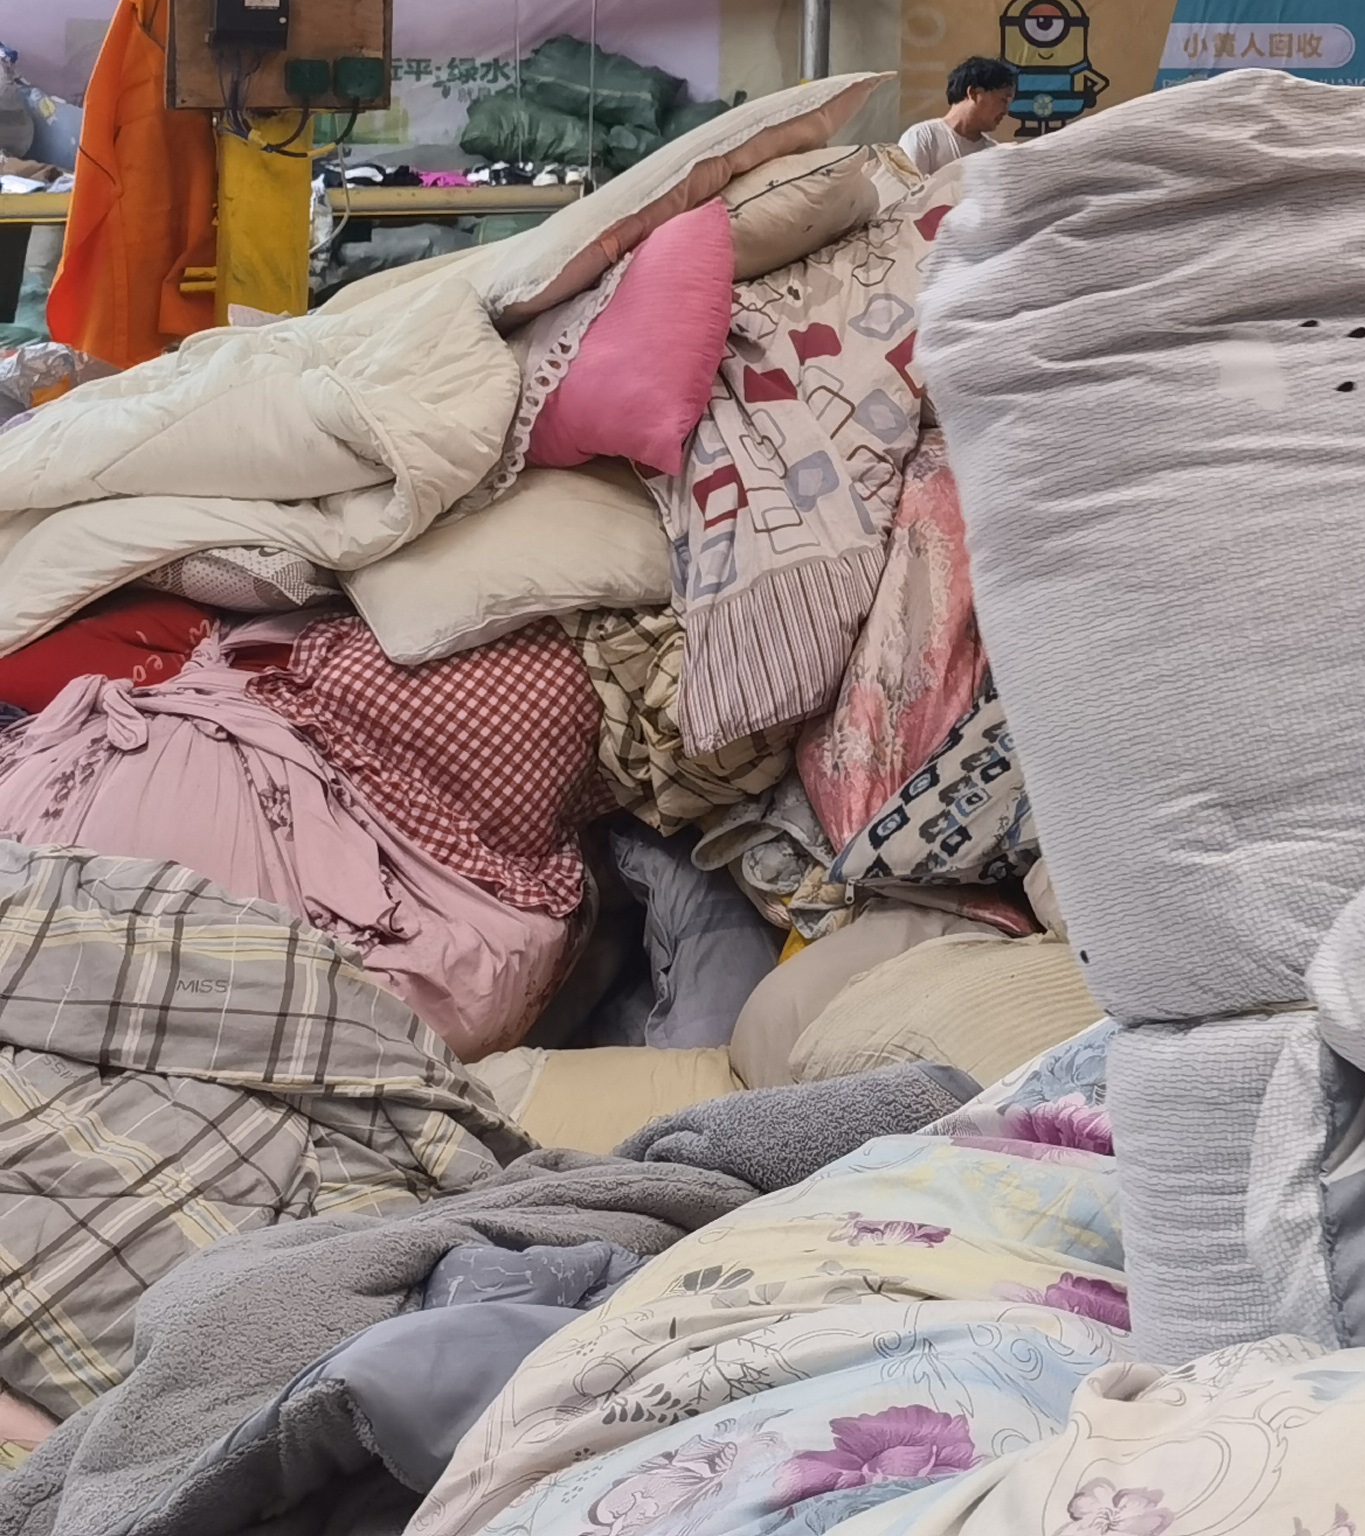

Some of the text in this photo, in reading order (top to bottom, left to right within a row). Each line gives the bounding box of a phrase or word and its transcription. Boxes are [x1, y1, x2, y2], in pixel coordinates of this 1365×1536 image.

[1183, 32, 1323, 59] 小黄人回收
[176, 979, 228, 994] MISS
